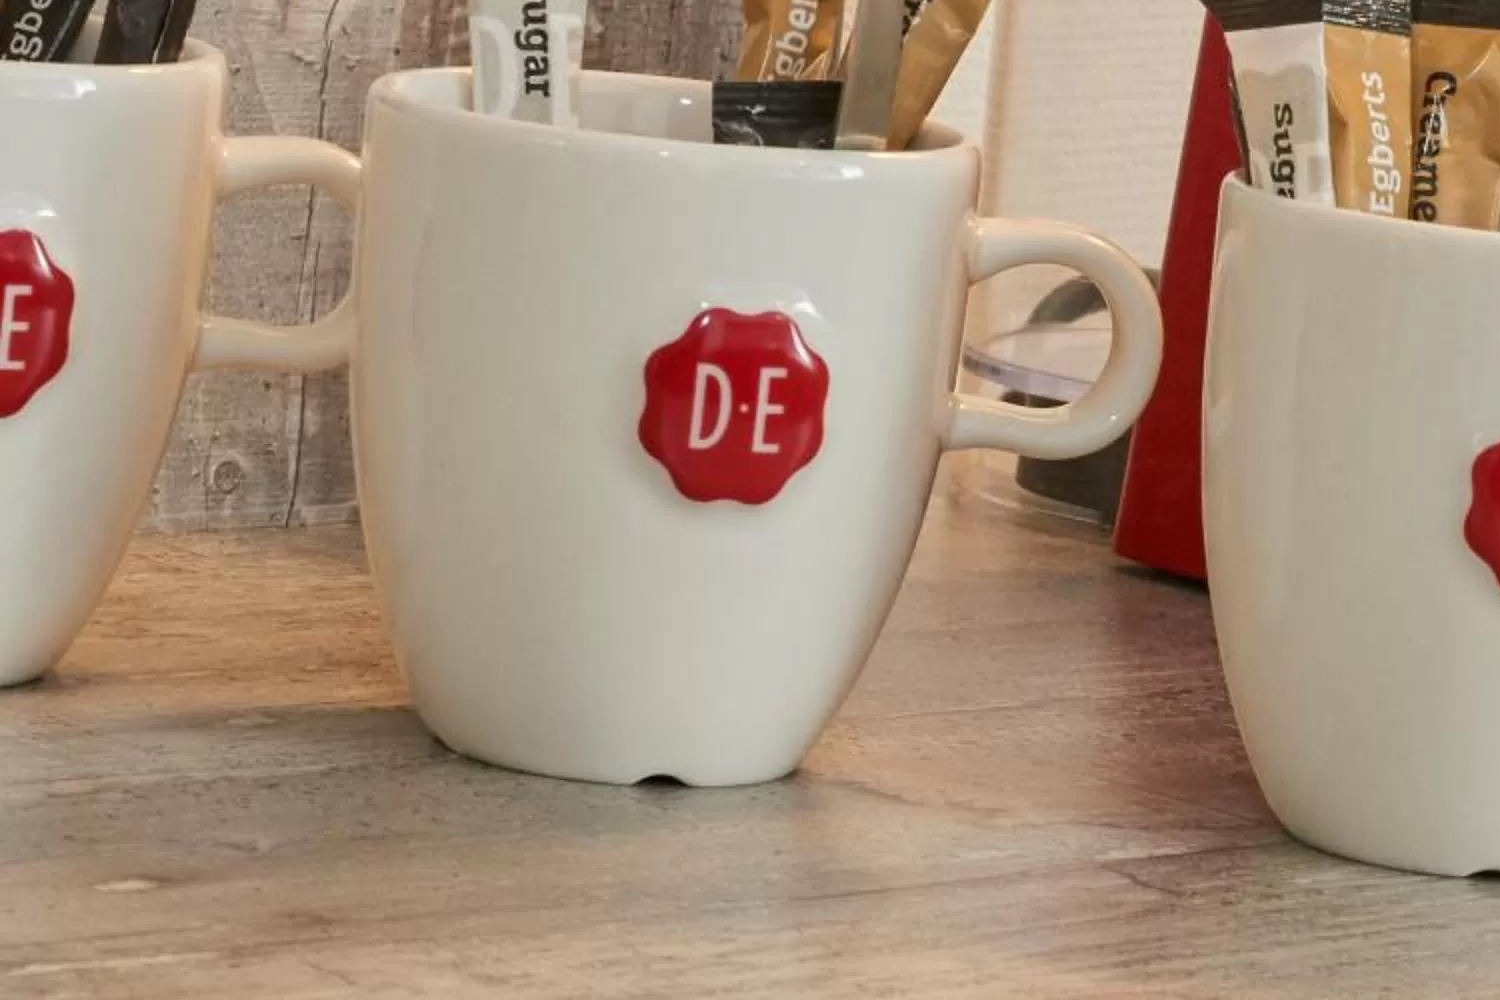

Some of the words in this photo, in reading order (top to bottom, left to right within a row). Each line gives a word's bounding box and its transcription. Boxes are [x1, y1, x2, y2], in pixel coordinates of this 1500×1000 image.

[1270, 103, 1295, 200] Sug
[1360, 71, 1401, 216] Egberts
[1411, 71, 1458, 222] Creame
